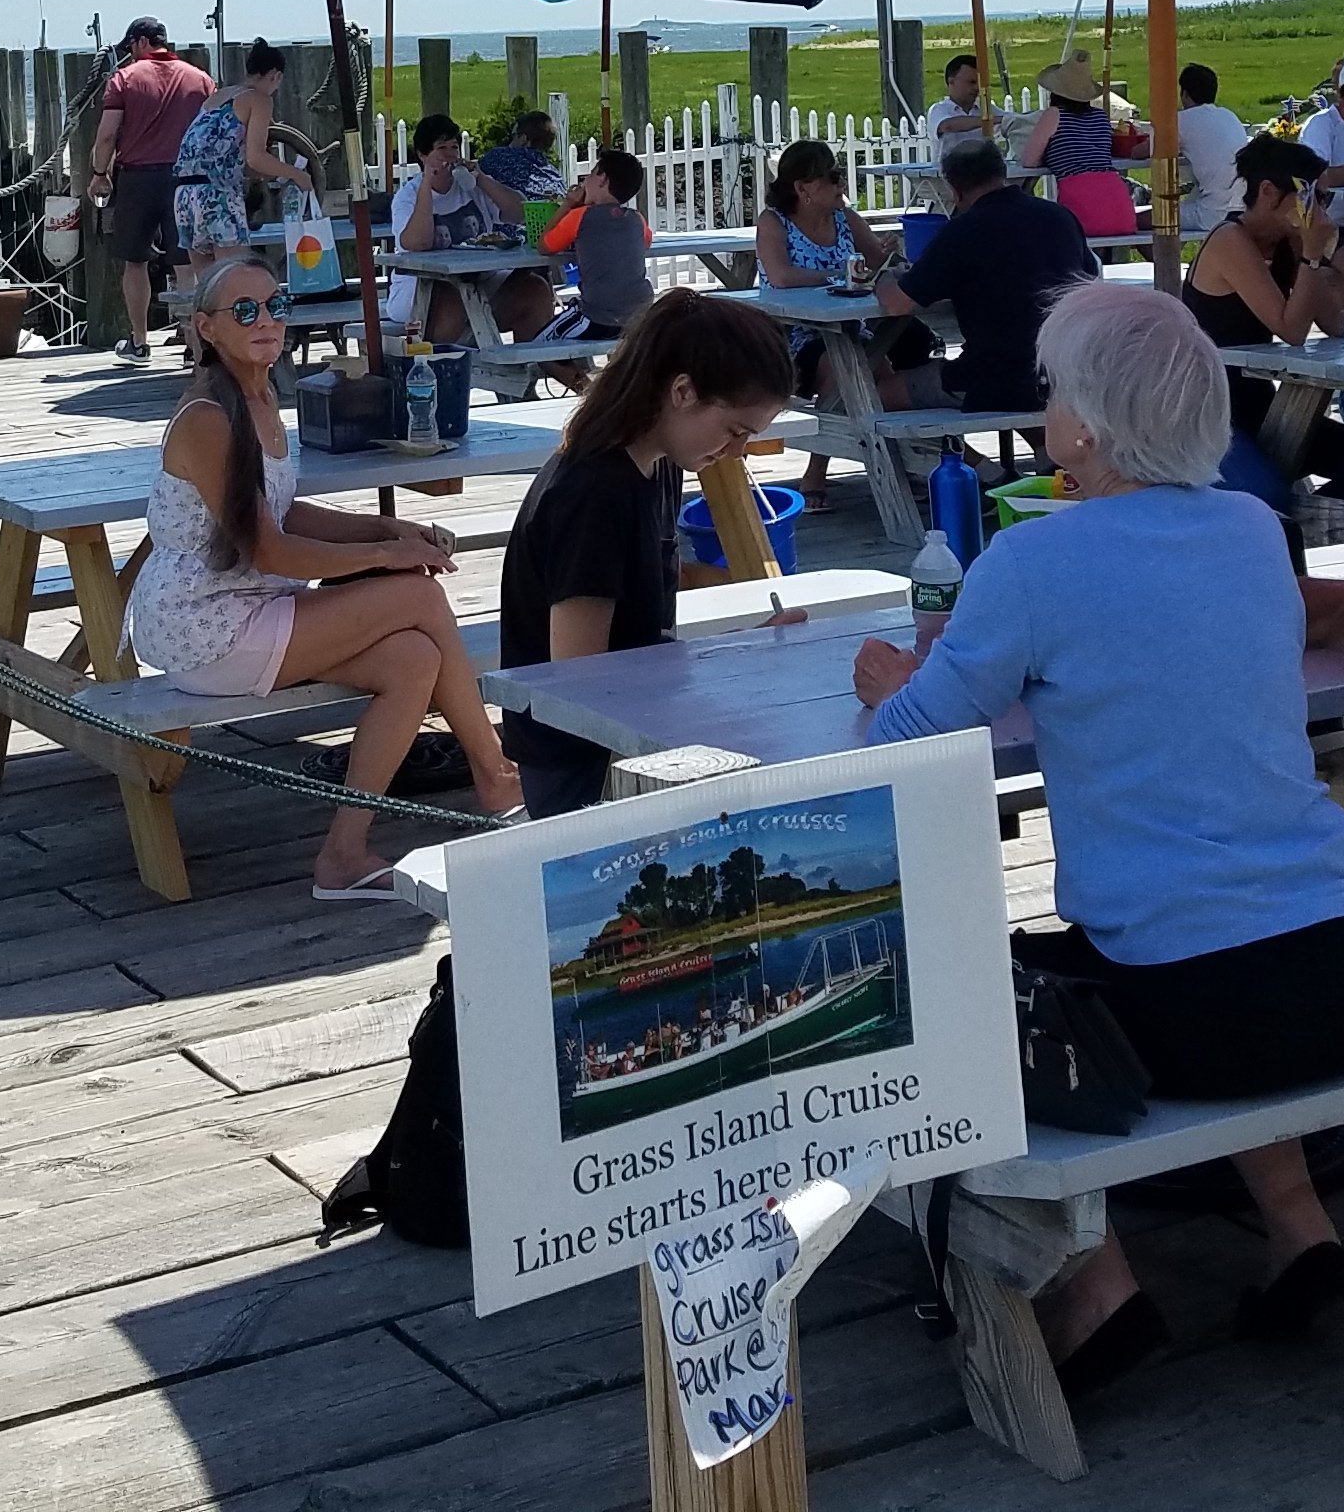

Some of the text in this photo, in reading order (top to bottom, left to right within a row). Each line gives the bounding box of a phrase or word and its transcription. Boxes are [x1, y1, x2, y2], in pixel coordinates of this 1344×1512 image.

[592, 841, 670, 882] Grass
[572, 1071, 921, 1196] Grass Island Cruise
[512, 1229, 597, 1278] Line
[607, 1186, 707, 1255] starts
[714, 1159, 792, 1210] here
[799, 1141, 855, 1183] for
[653, 1221, 735, 1298] grass
[671, 1276, 768, 1347] Cruise
[746, 1328, 780, 1371] @
